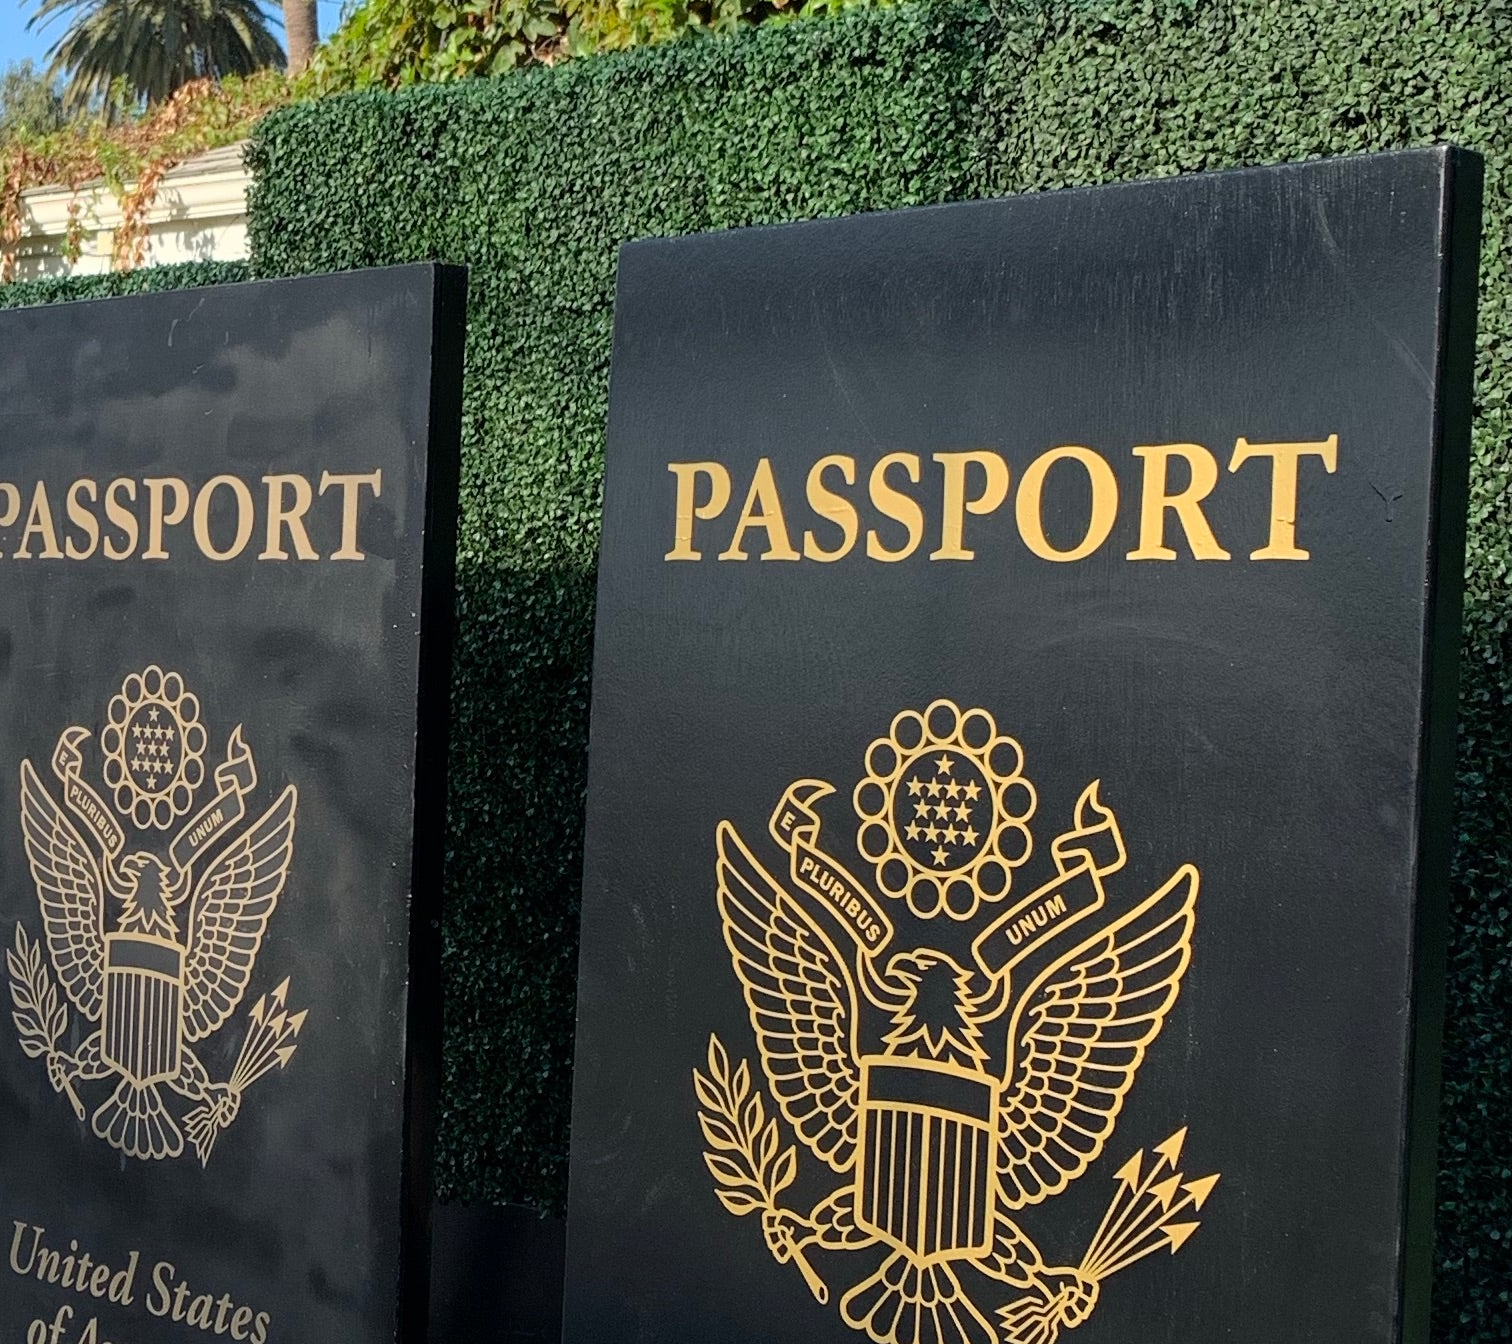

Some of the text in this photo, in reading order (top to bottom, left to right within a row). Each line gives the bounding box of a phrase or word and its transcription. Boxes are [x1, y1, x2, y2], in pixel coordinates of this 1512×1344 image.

[663, 433, 1340, 564] PASSPORT
[59, 752, 224, 849] E PLURIBUS UNUM
[780, 811, 1068, 946] E PLURIBUS UNUM
[8, 1220, 140, 1306] United
